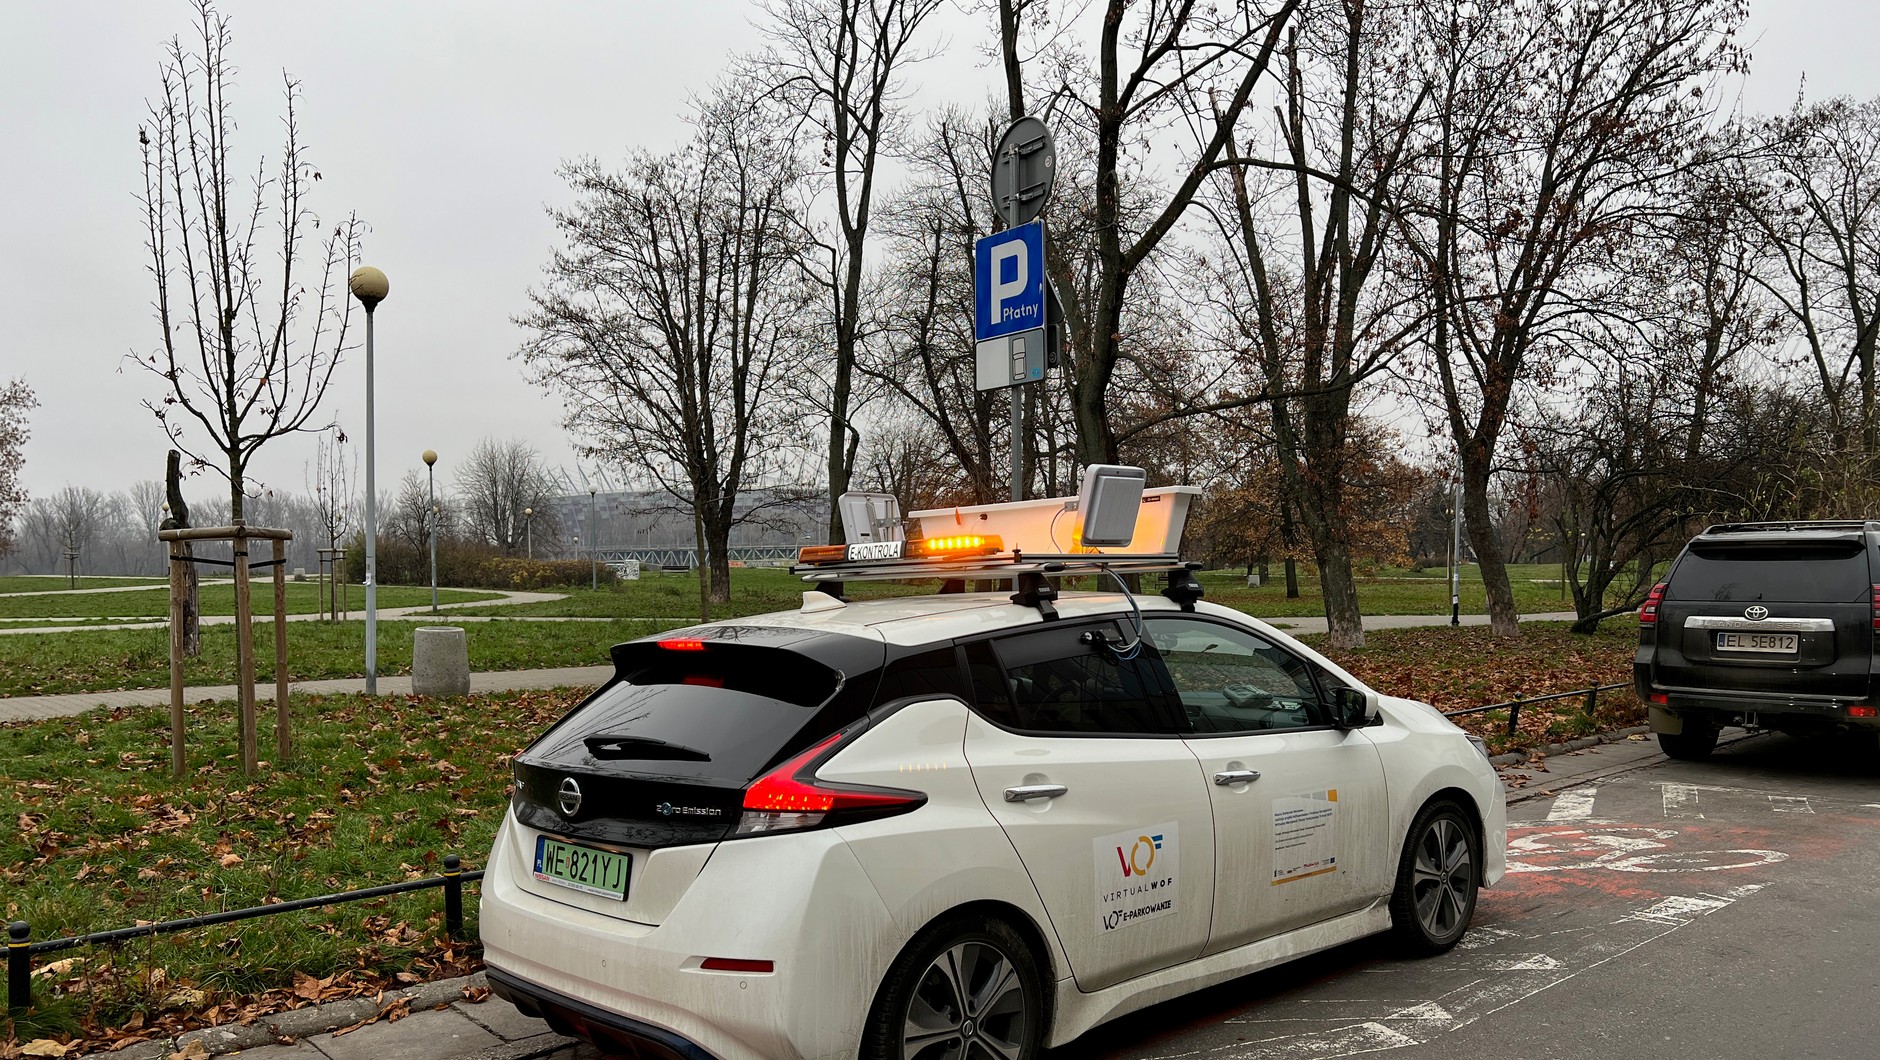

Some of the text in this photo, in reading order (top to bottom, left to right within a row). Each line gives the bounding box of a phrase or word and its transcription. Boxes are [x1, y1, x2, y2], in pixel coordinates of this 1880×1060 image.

[990, 238, 1028, 325] P
[1003, 303, 1039, 322] Płatny
[850, 544, 899, 560] E-KONTROLA
[1726, 635, 1746, 648] EL
[1751, 635, 1794, 649] 5E812
[545, 843, 566, 876] WE
[569, 849, 622, 889] 821YJ
[1123, 899, 1172, 922] E-PARKOWANIE
